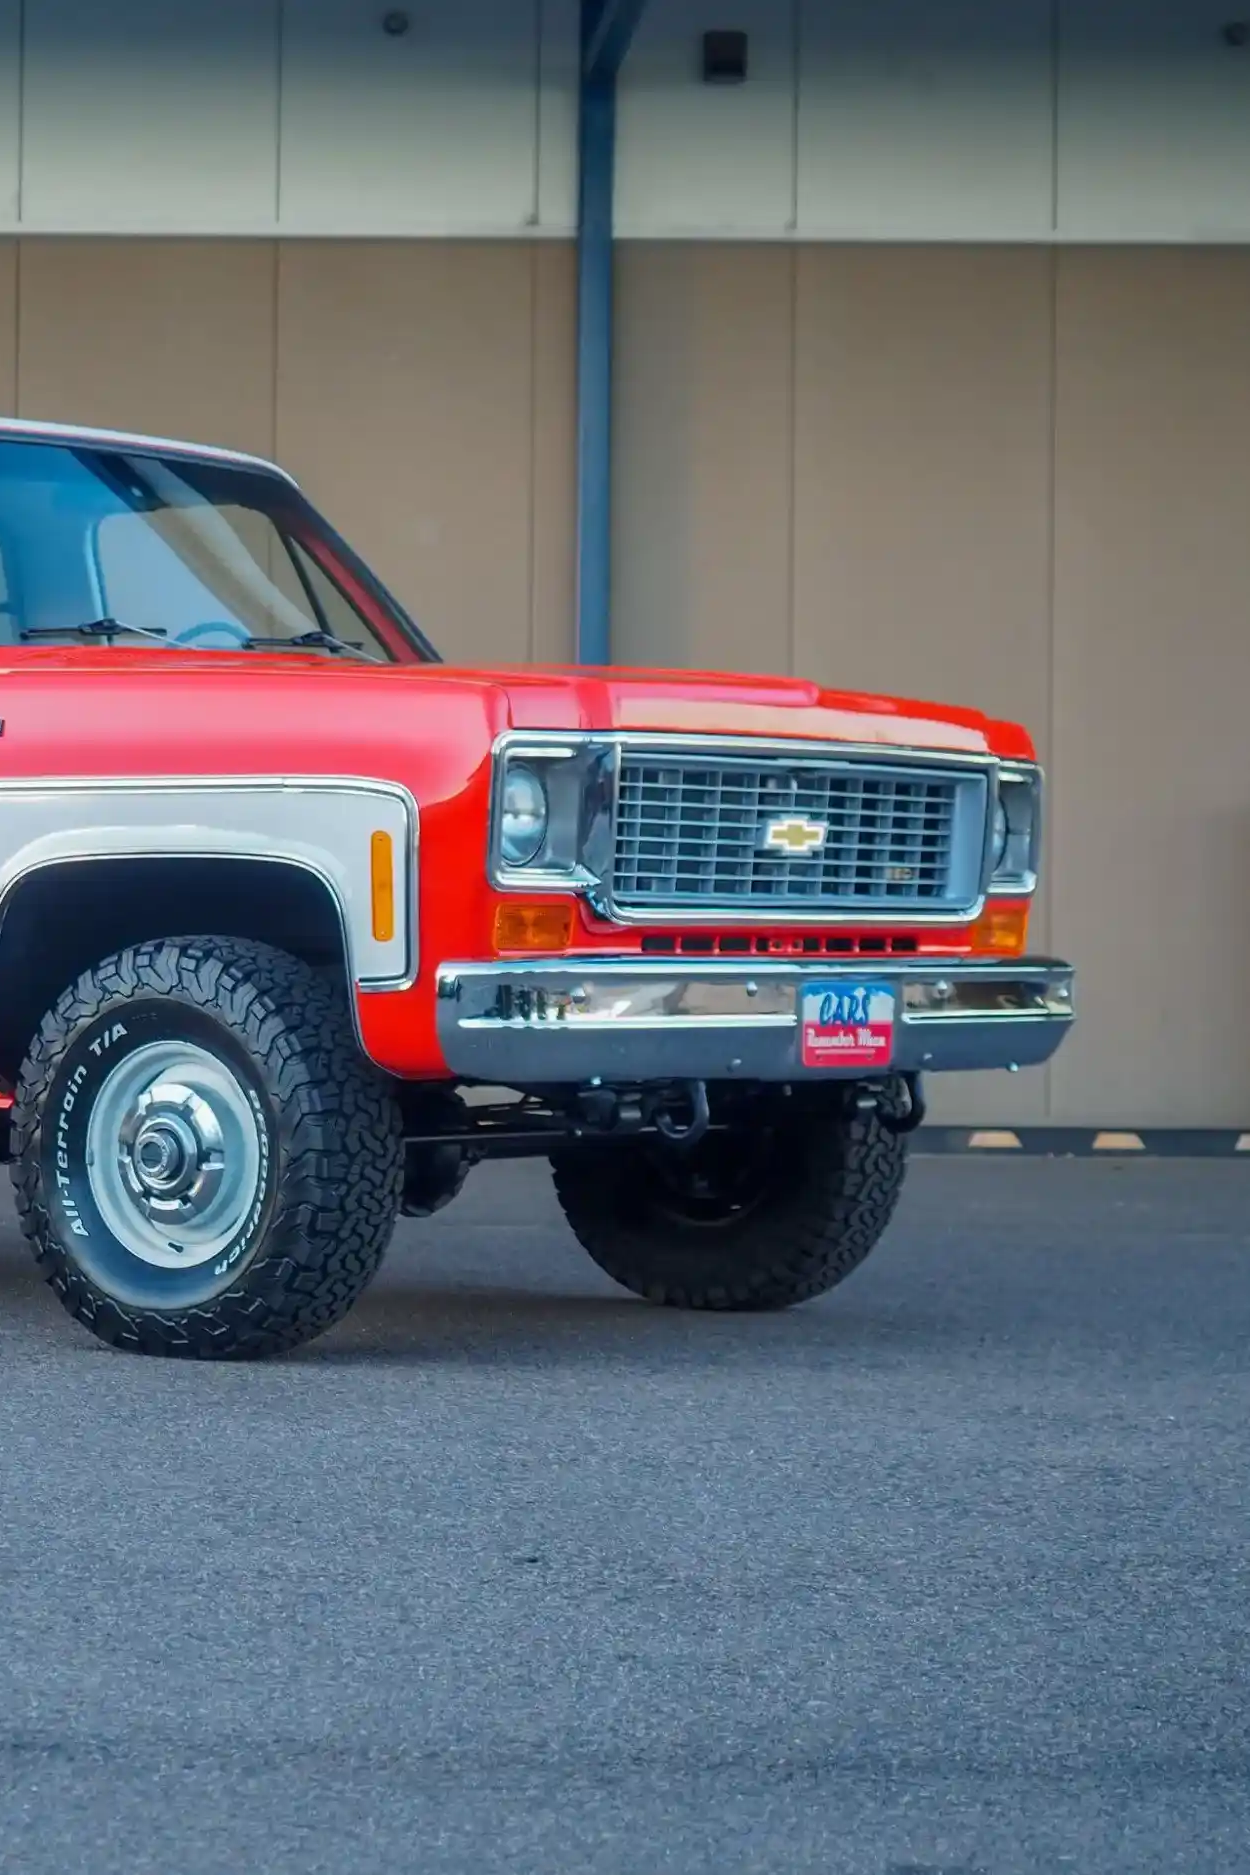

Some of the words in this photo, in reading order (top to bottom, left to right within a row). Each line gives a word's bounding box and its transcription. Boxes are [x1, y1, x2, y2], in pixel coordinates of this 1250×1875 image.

[819, 993, 870, 1027] CARS
[55, 1065, 90, 1237] All-Terrain
[88, 1022, 128, 1057] T/A
